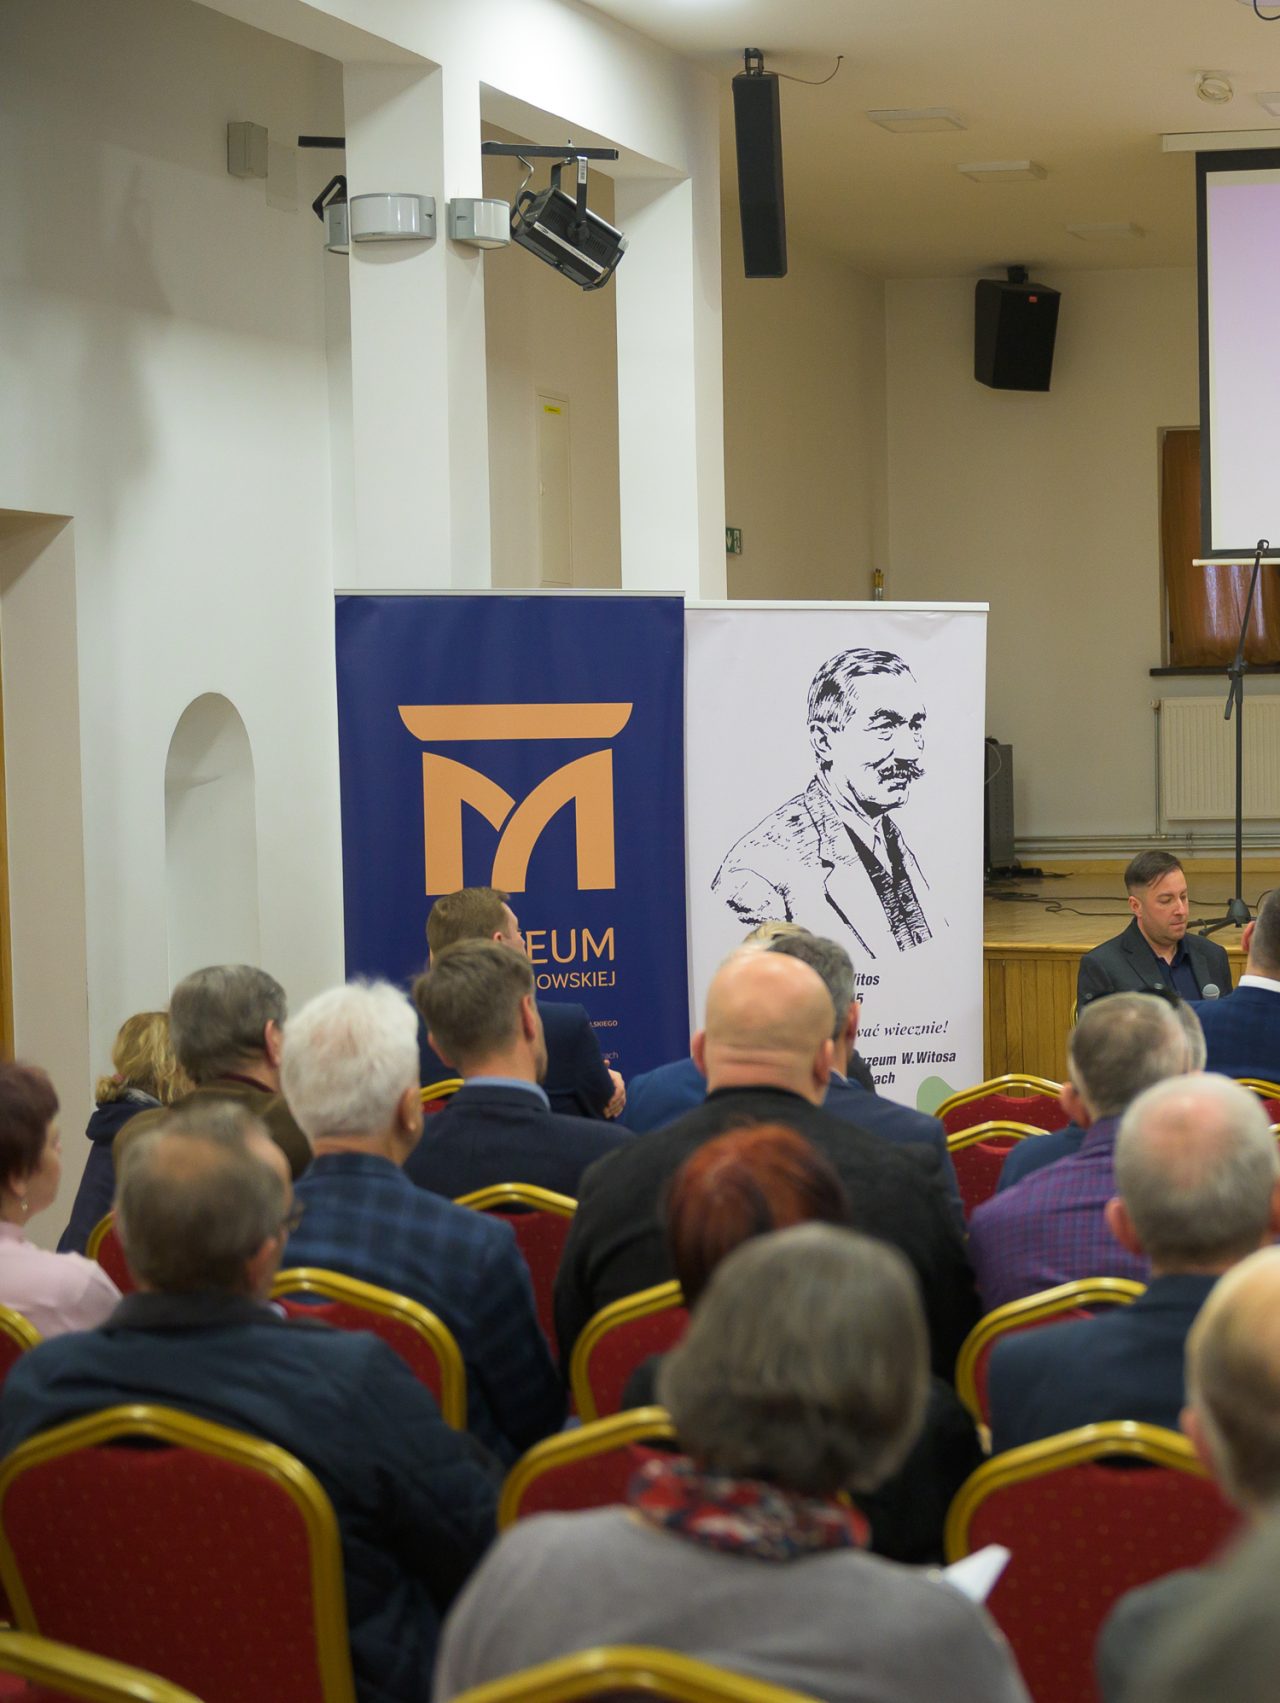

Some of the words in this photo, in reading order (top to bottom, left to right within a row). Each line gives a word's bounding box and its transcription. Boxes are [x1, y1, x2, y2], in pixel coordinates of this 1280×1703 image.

[525, 926, 615, 964] EUM
[532, 971, 616, 990] OWSKIEJ
[884, 1020, 949, 1036] wiecznie!
[901, 1051, 957, 1065] W.Witosa
